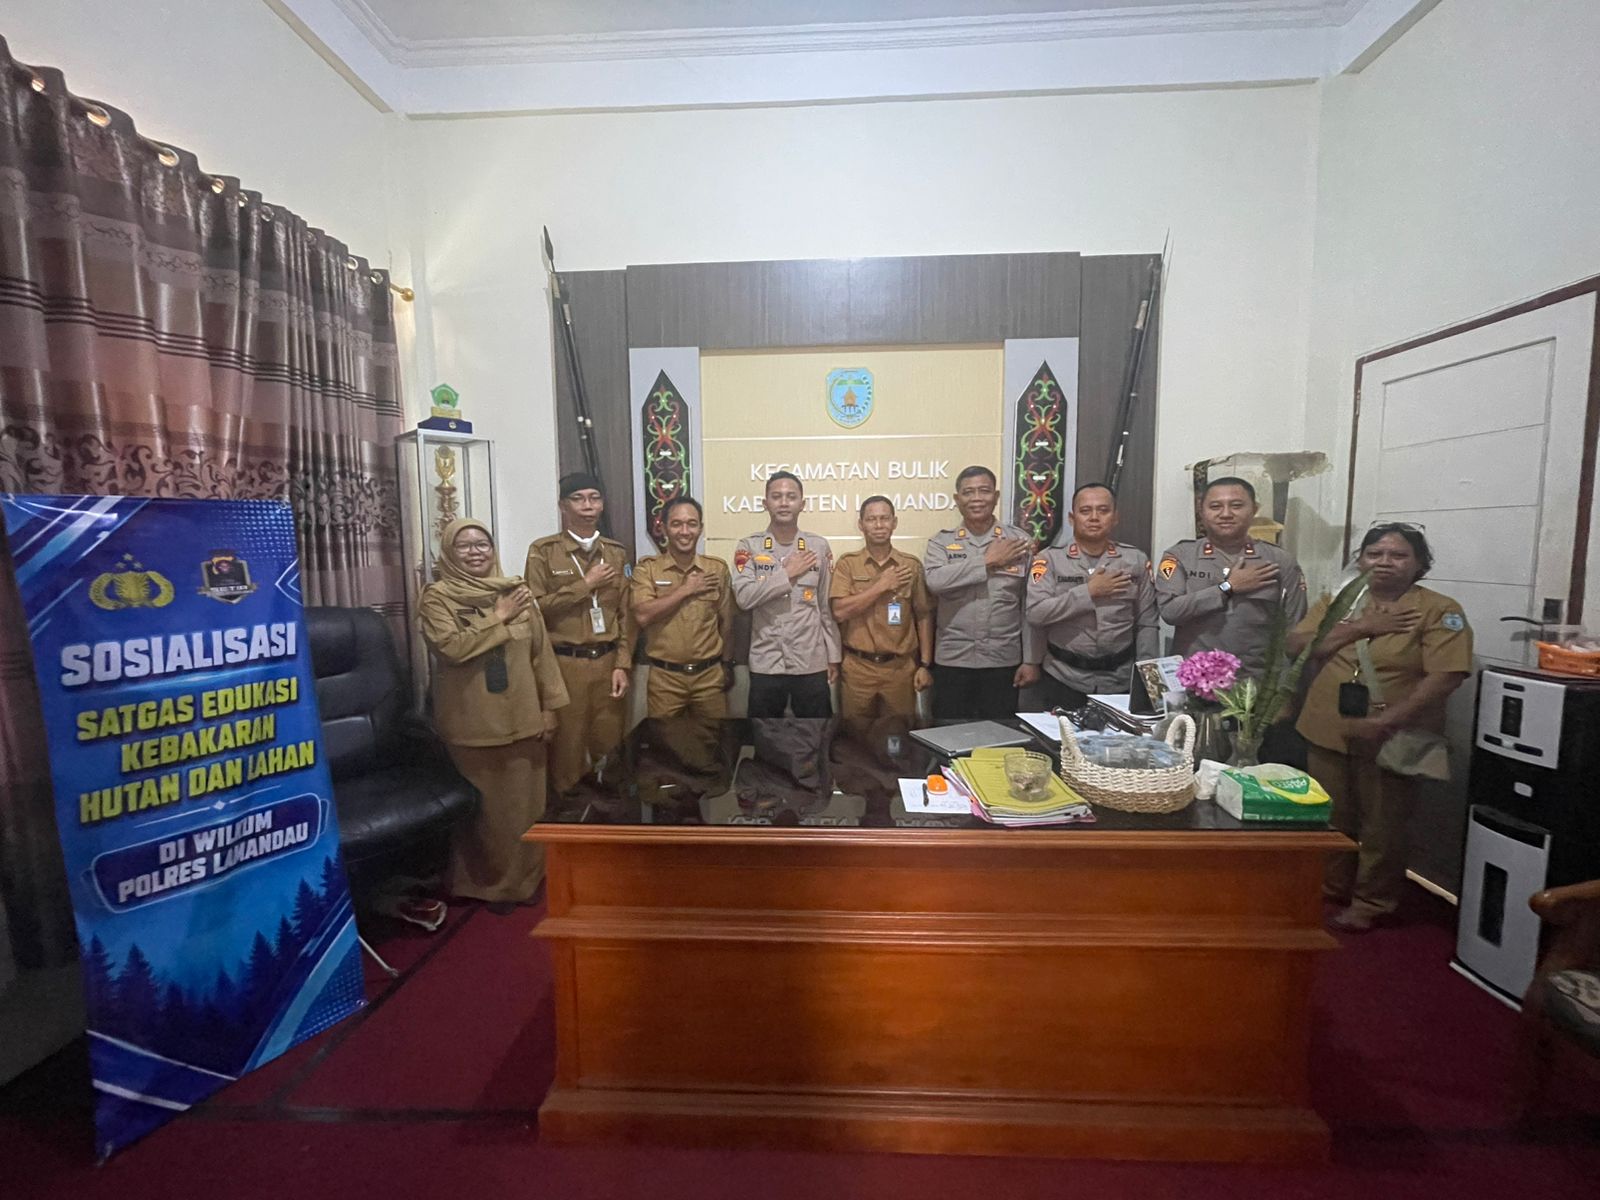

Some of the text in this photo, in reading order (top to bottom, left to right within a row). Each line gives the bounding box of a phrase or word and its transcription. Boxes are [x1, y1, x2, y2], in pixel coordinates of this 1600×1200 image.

[887, 460, 949, 479] BULIK
[723, 494, 847, 513] KABTEN
[61, 622, 297, 687] SOSIALISASI
[76, 677, 297, 741] SATGAS EDUKASI
[121, 713, 275, 773] KEBAKARAN
[79, 740, 315, 824] HUTAN DAN LAHAN
[118, 822, 309, 903] POLRES LAMANDAU
[159, 837, 186, 865] DI
